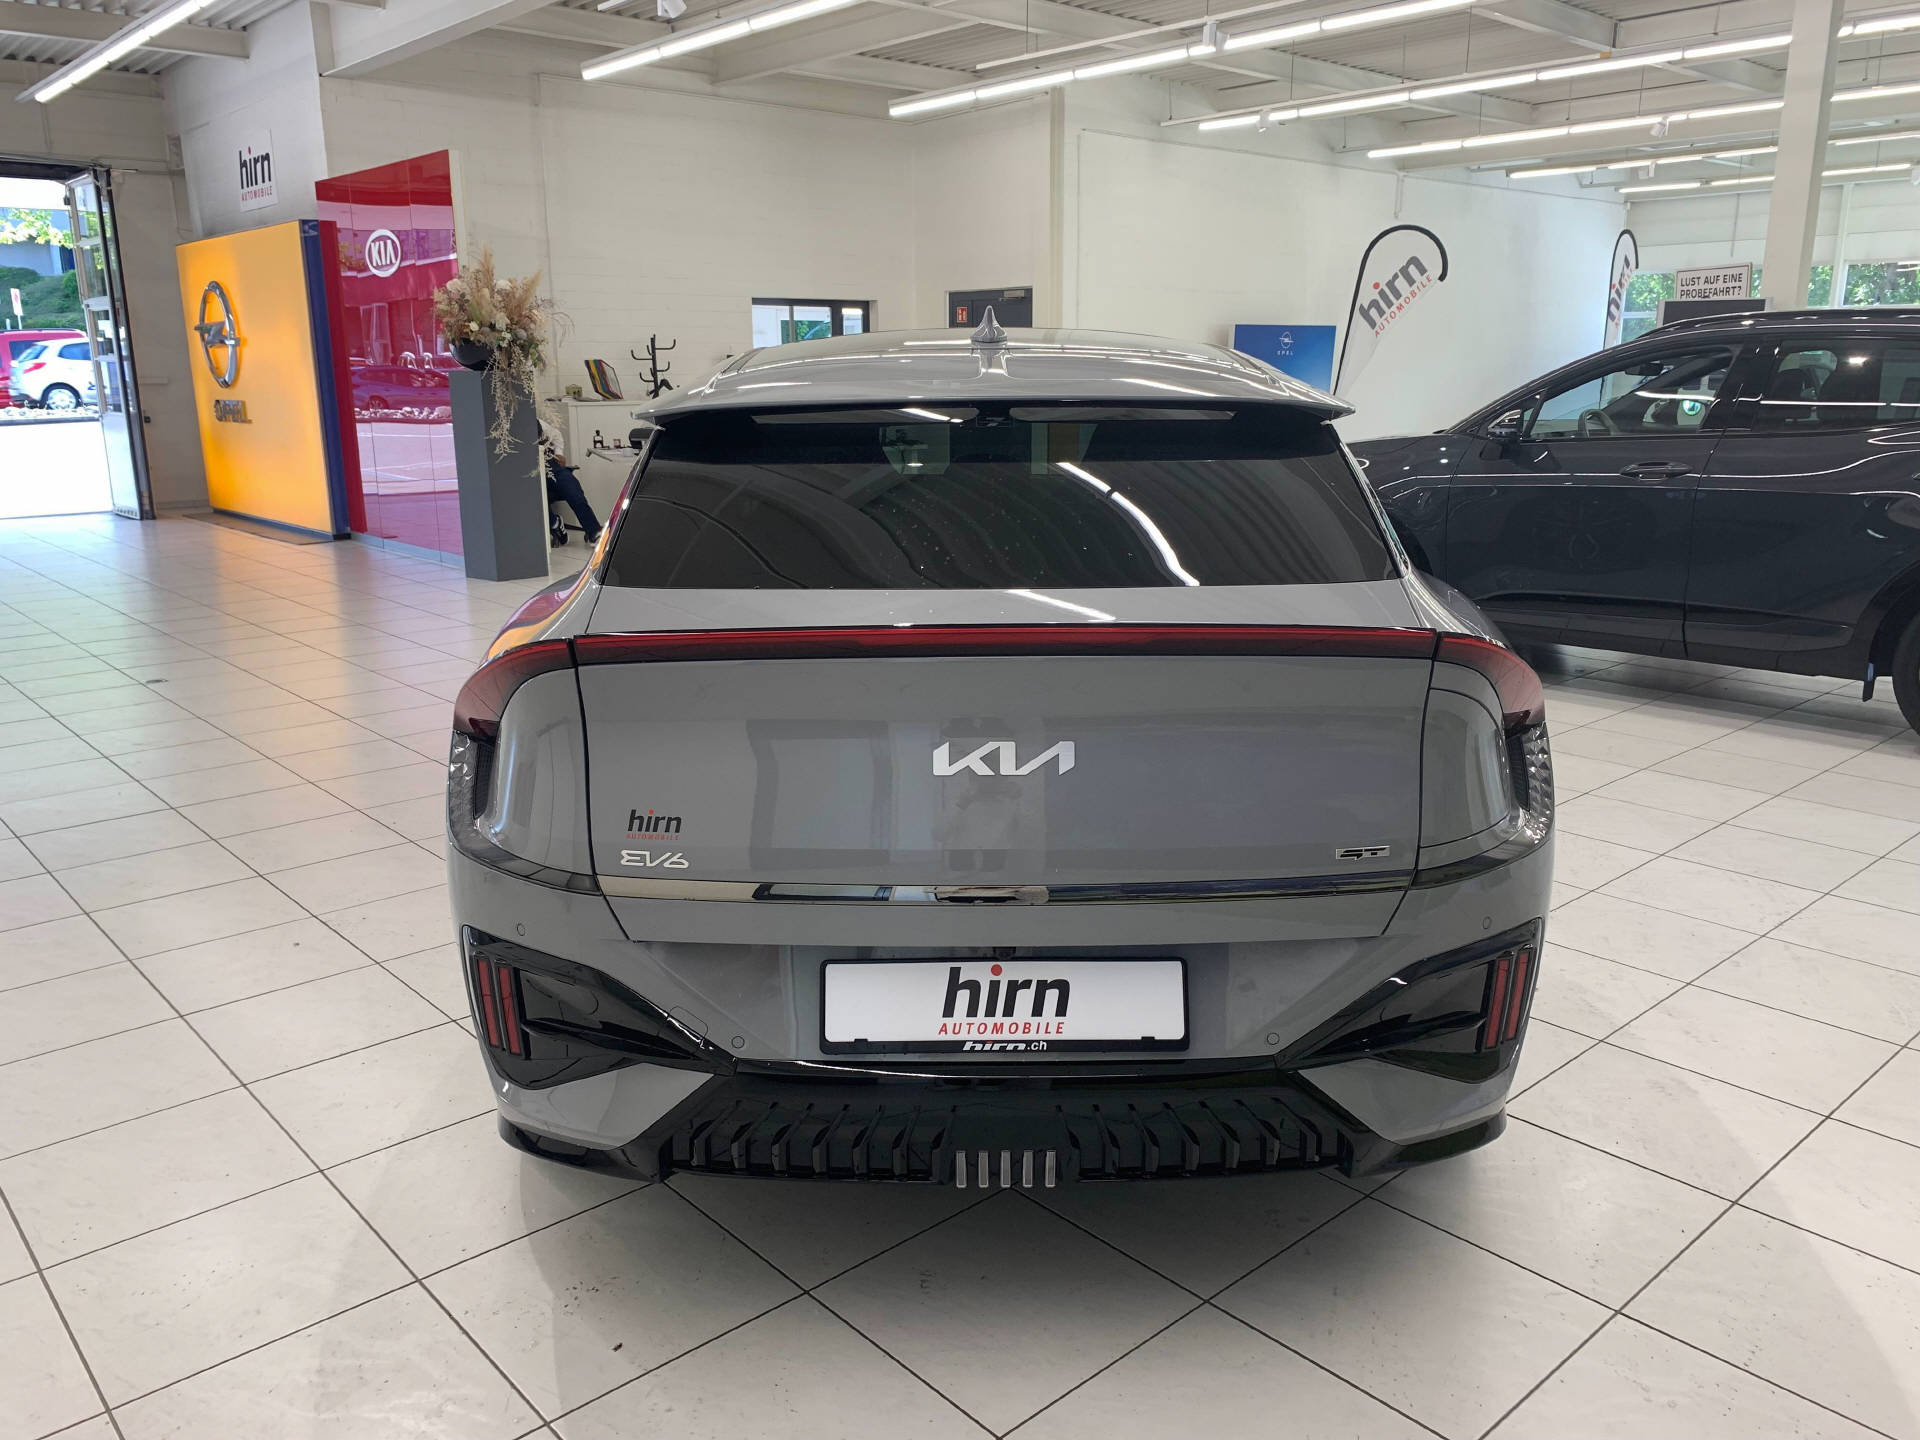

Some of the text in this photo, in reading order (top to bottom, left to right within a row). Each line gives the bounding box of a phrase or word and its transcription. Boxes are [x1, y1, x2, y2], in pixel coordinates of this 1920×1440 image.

[239, 146, 272, 190] hirn
[370, 239, 397, 267] KIA
[1359, 255, 1428, 330] hirn
[1680, 272, 1744, 287] LUST AUF EINE
[1680, 285, 1742, 299] PROBEFAHRT?
[1374, 274, 1432, 337] AUTOMOBILE
[933, 740, 1076, 776] KIA
[627, 808, 682, 833] hirn
[620, 849, 689, 869] EV6
[942, 963, 1071, 1018] hirn
[938, 1021, 1065, 1035] AUTOMOBILE
[962, 1040, 1047, 1051] hirn.ch
